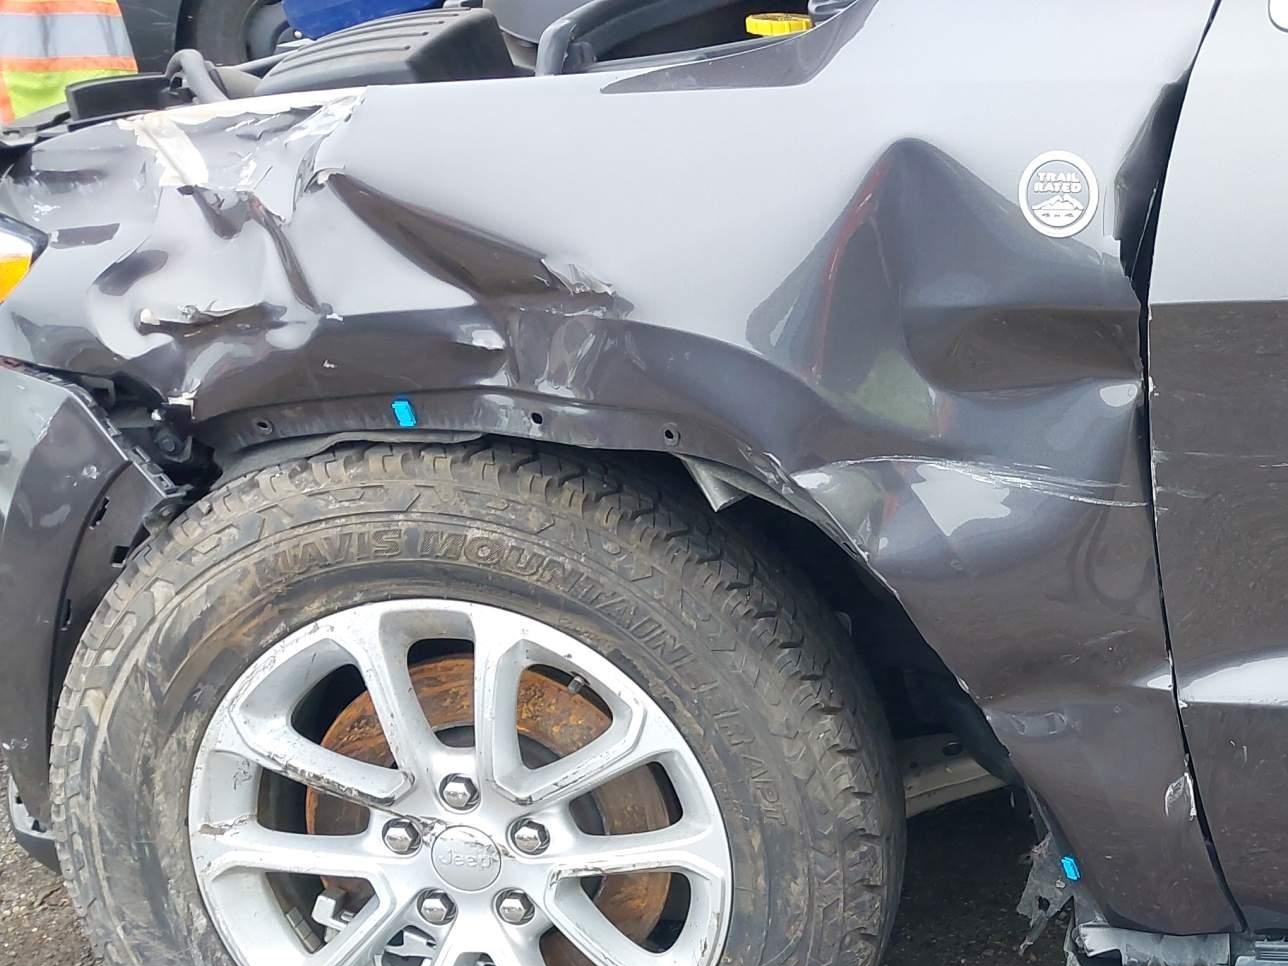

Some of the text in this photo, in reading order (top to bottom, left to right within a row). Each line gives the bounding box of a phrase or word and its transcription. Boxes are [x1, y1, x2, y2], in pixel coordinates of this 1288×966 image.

[1037, 172, 1080, 182] TRAIL
[1033, 182, 1082, 193] RATED
[437, 849, 493, 870] Jeep
